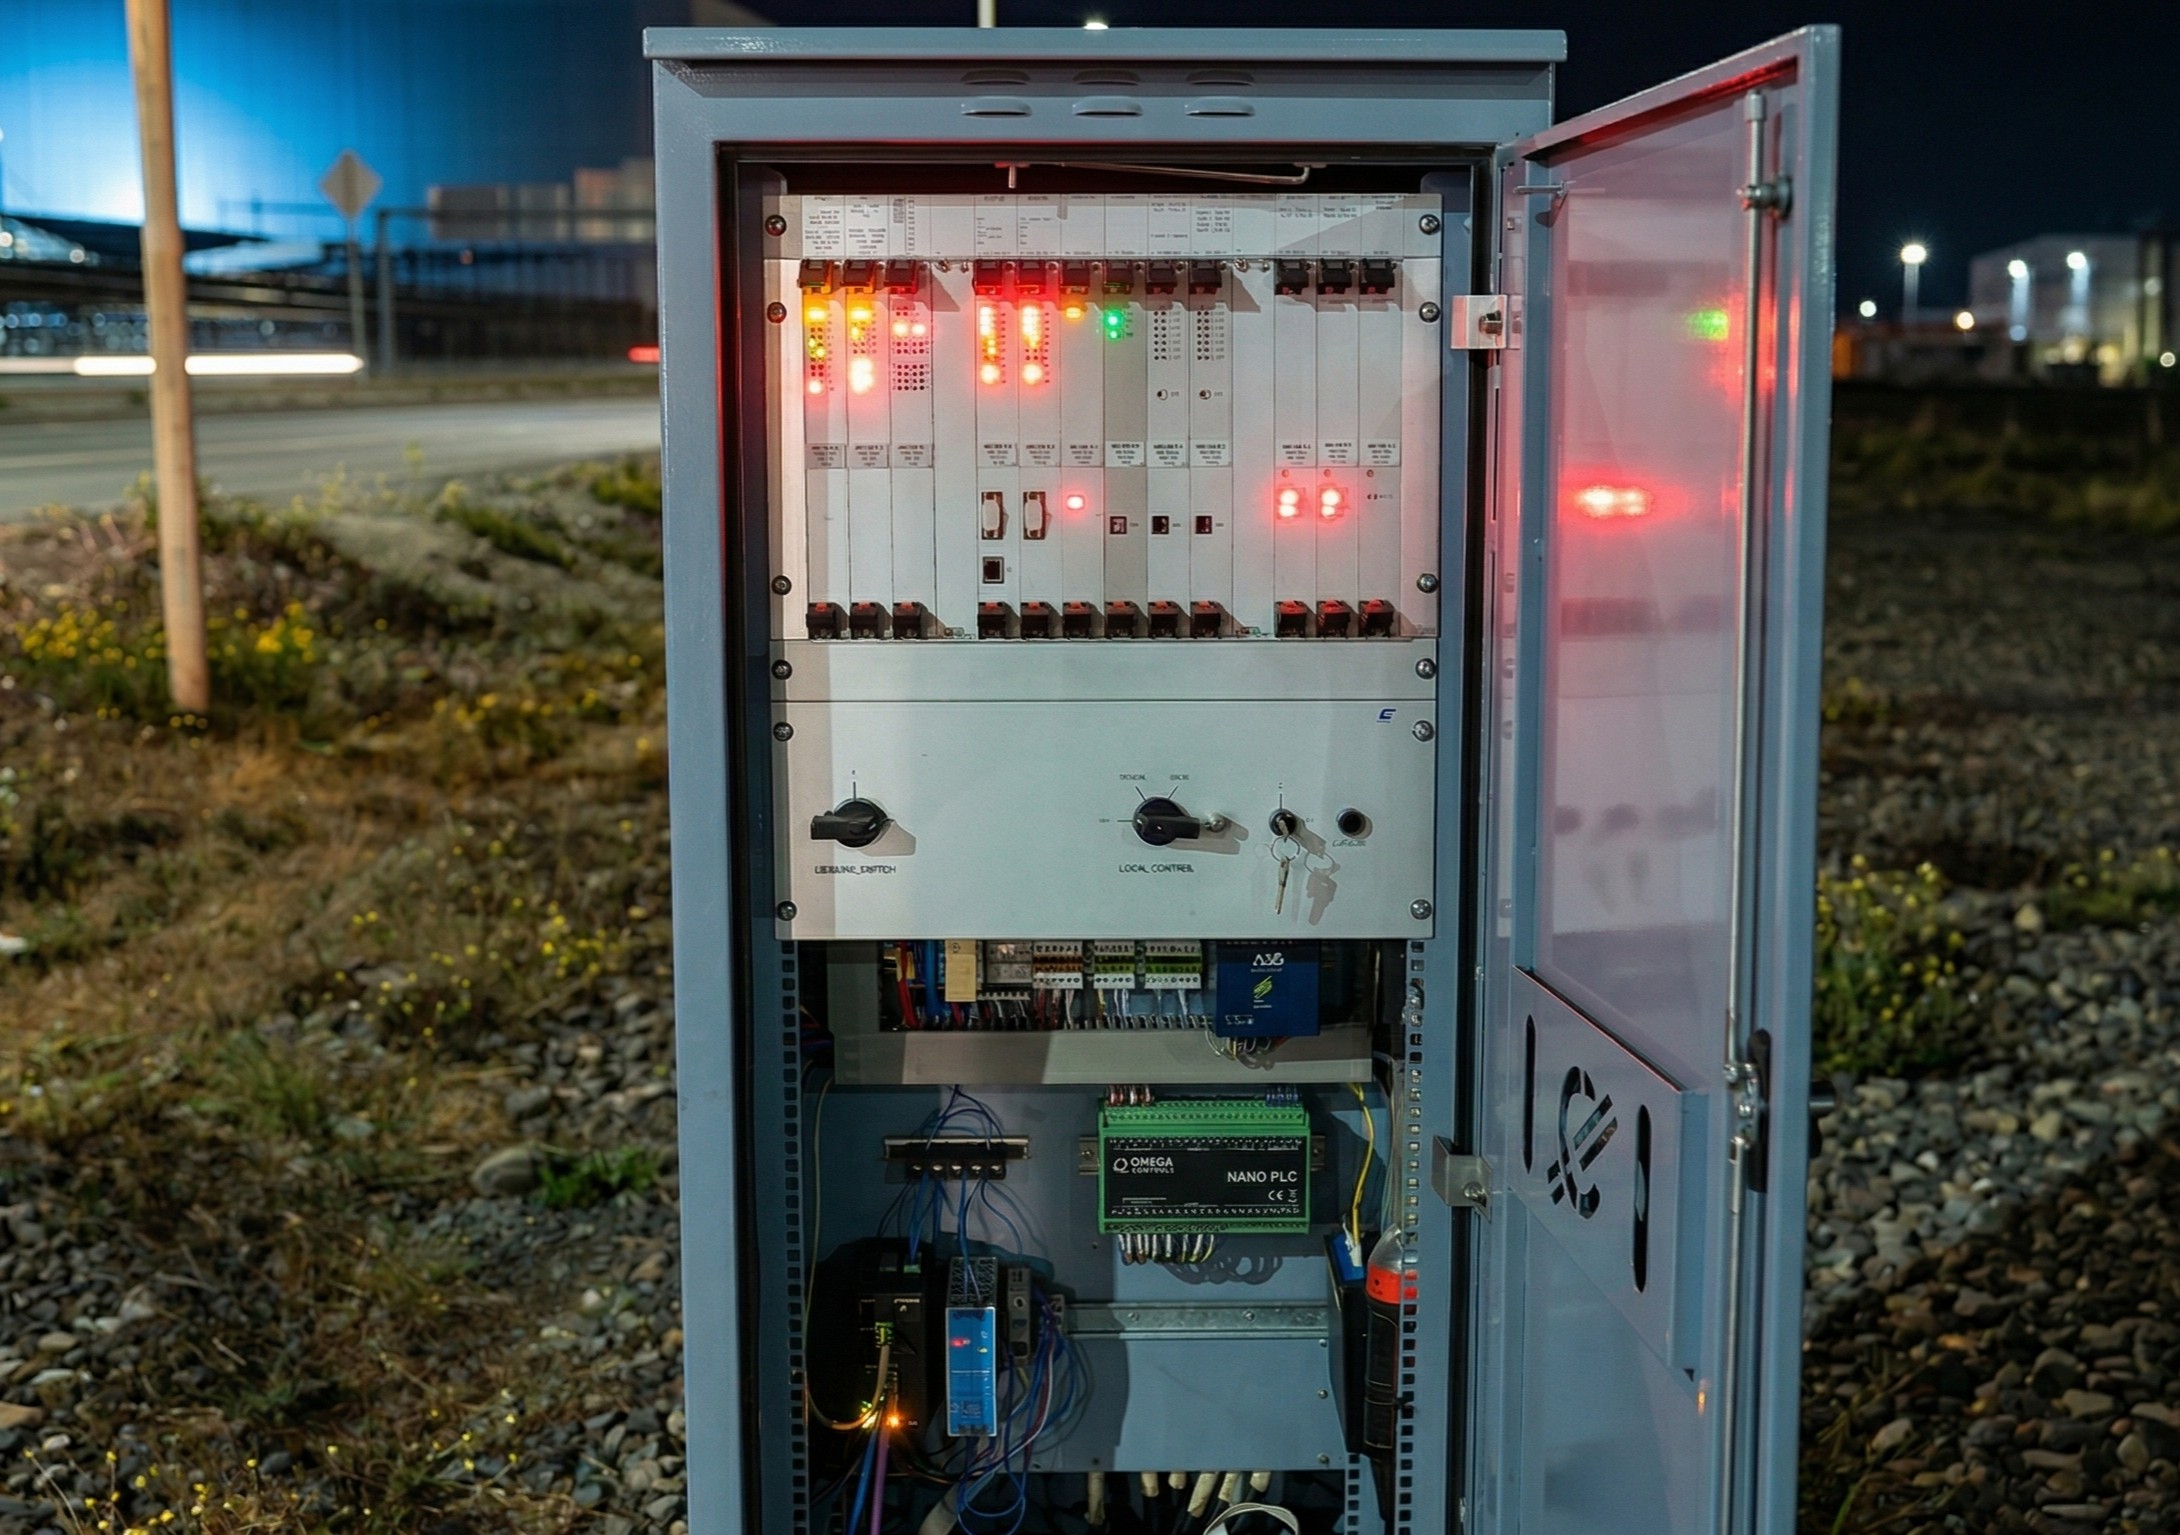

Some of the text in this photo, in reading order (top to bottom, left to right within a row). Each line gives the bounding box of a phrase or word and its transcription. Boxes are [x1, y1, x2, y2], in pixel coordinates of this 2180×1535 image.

[1130, 1156, 1174, 1167] OMEGA
[1227, 1170, 1298, 1183] NANO PLC
